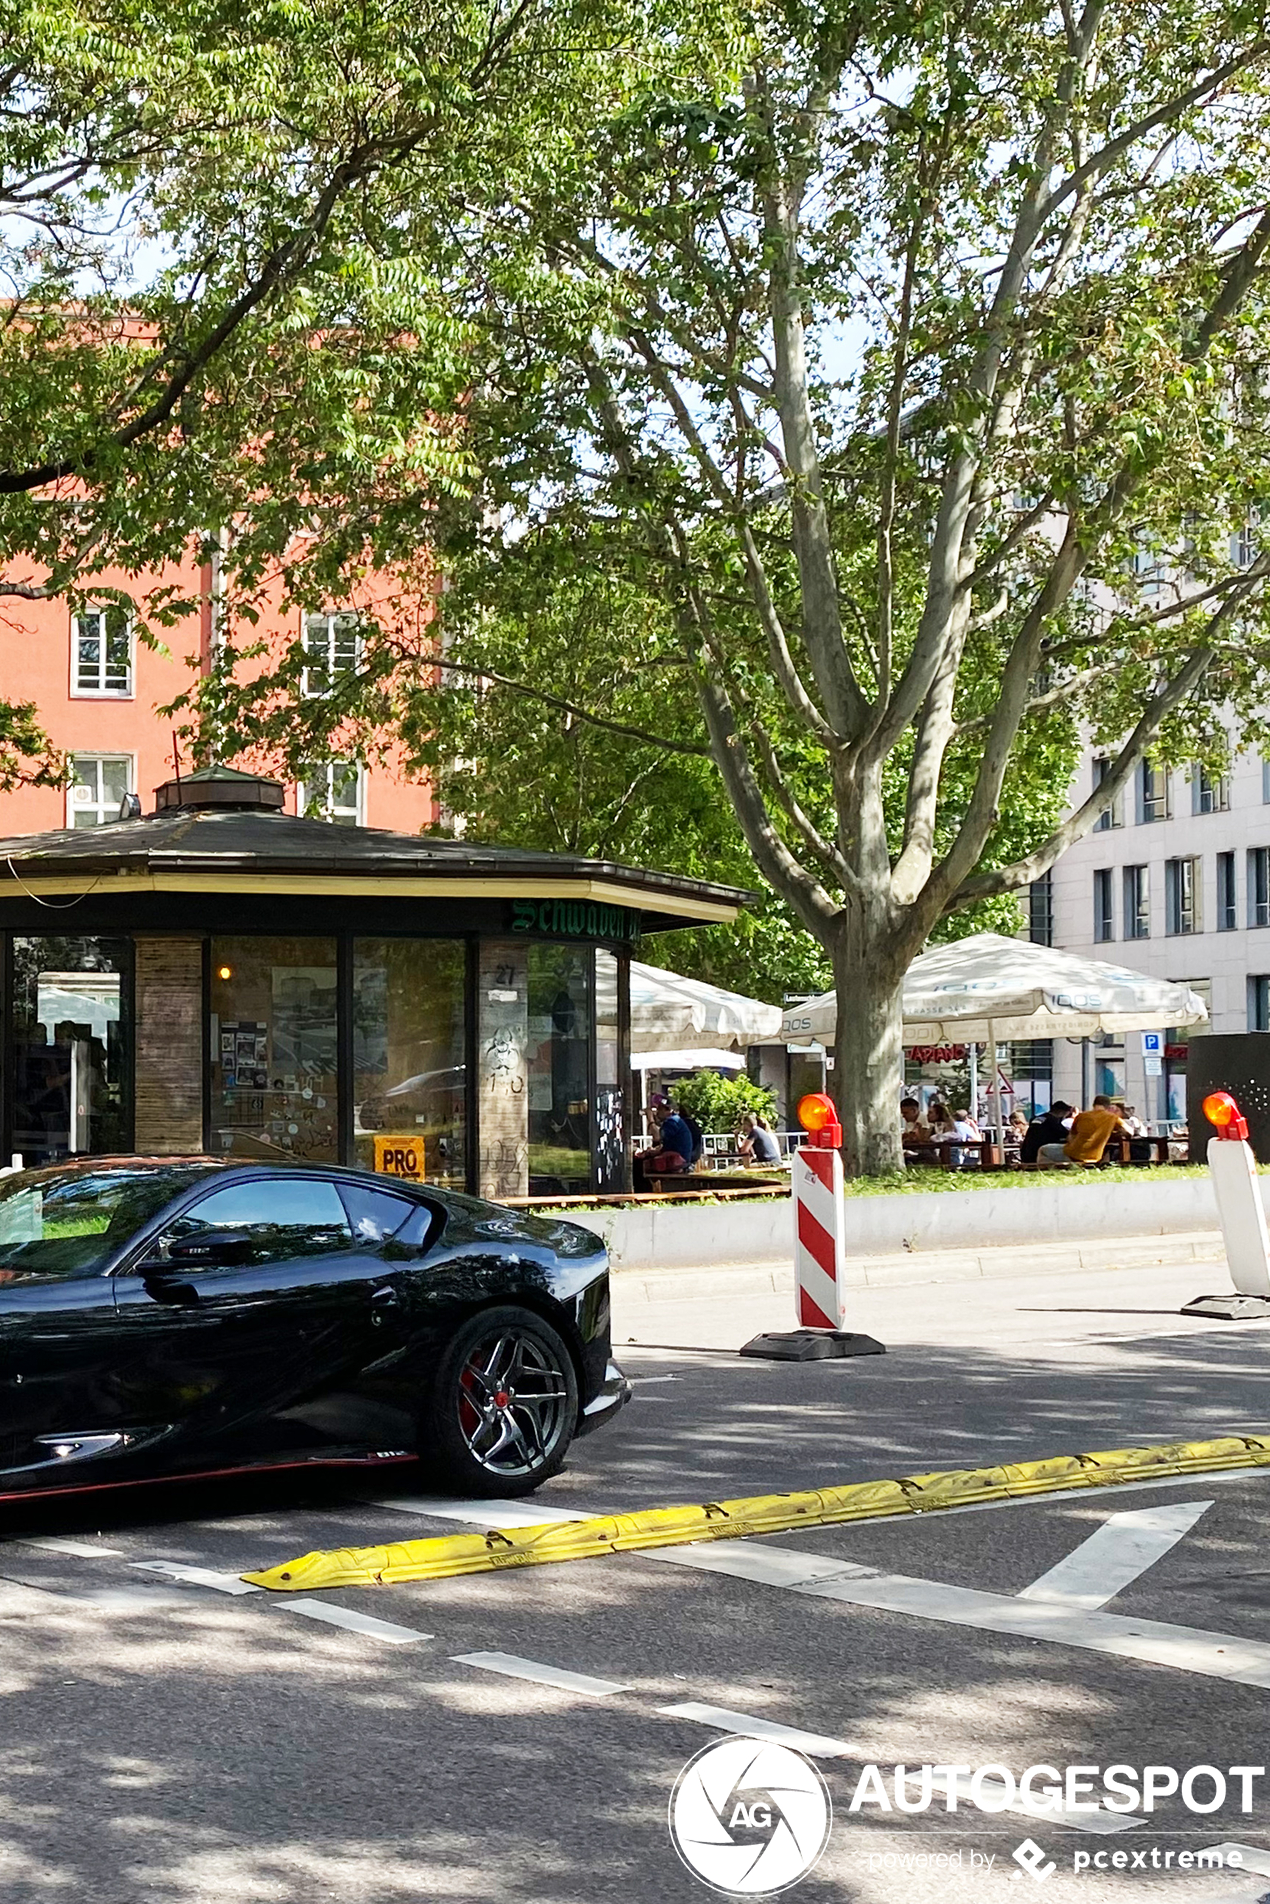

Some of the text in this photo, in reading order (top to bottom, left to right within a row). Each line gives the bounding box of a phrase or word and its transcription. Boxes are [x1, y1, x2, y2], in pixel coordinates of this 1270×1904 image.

[1052, 994, 1102, 1008] IQOS
[782, 1017, 811, 1032] QOS
[383, 1149, 417, 1171] PRO
